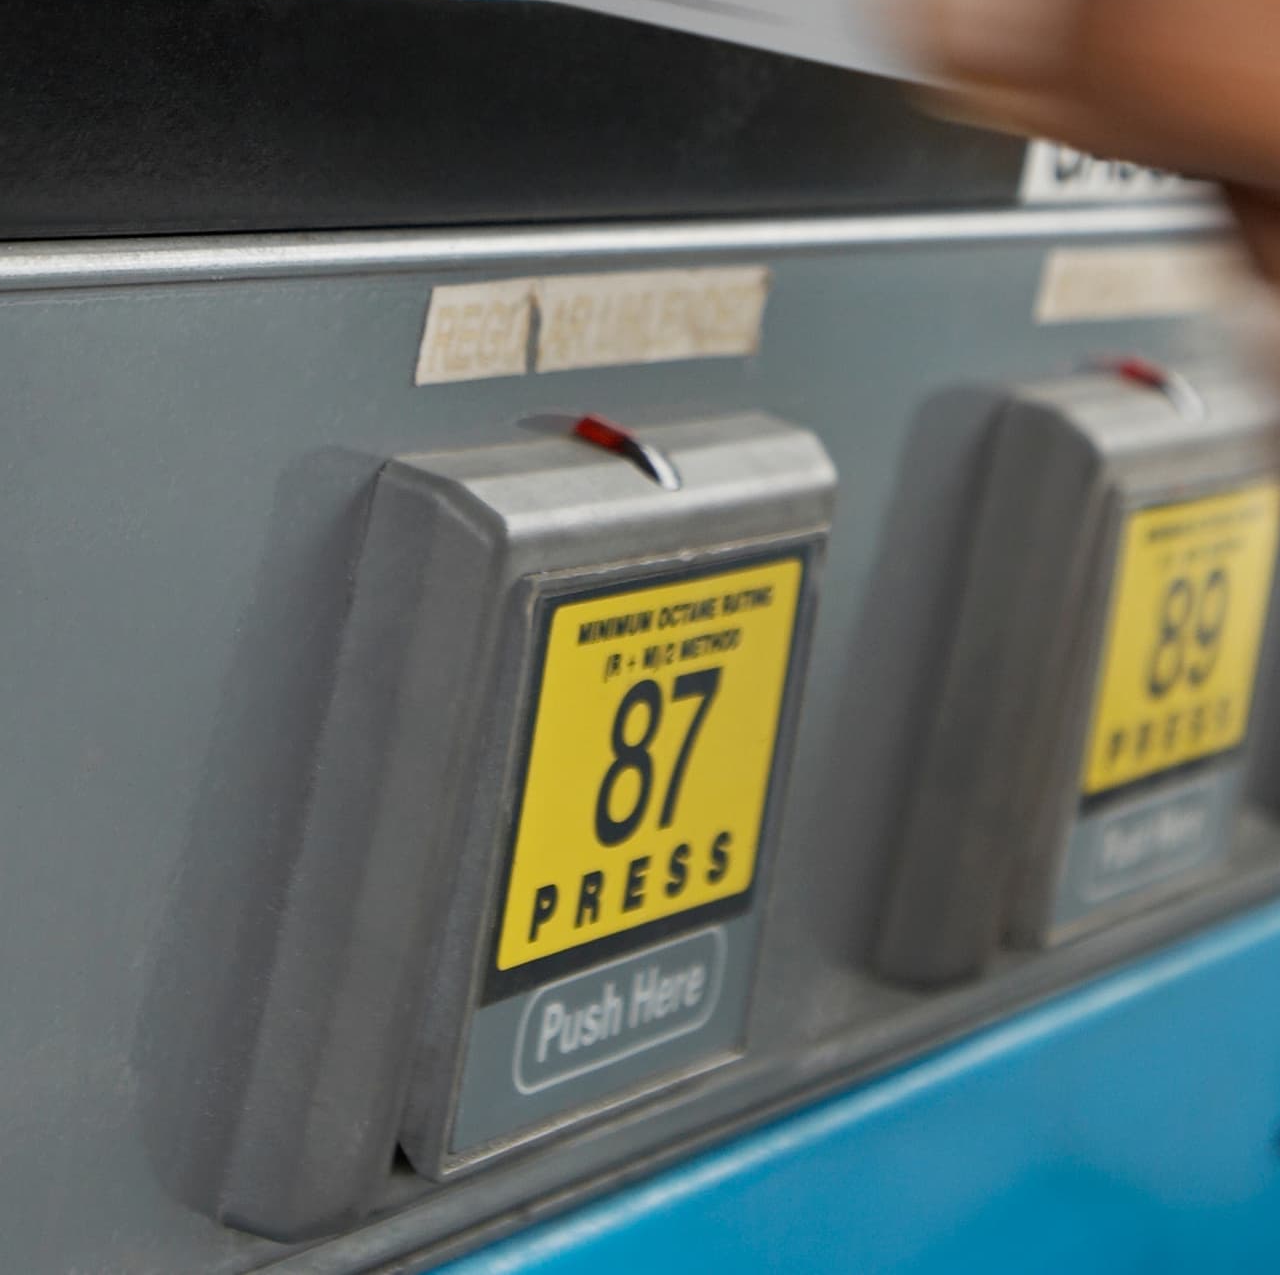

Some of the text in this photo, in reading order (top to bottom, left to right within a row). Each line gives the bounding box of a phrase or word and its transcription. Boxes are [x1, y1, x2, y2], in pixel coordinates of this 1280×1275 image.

[578, 610, 655, 645] MINIMUM
[657, 598, 719, 630] OCTANE
[1145, 566, 1228, 700] 89
[593, 666, 724, 848] 87
[528, 831, 732, 944] PRESS
[534, 963, 706, 1064] Push Here
